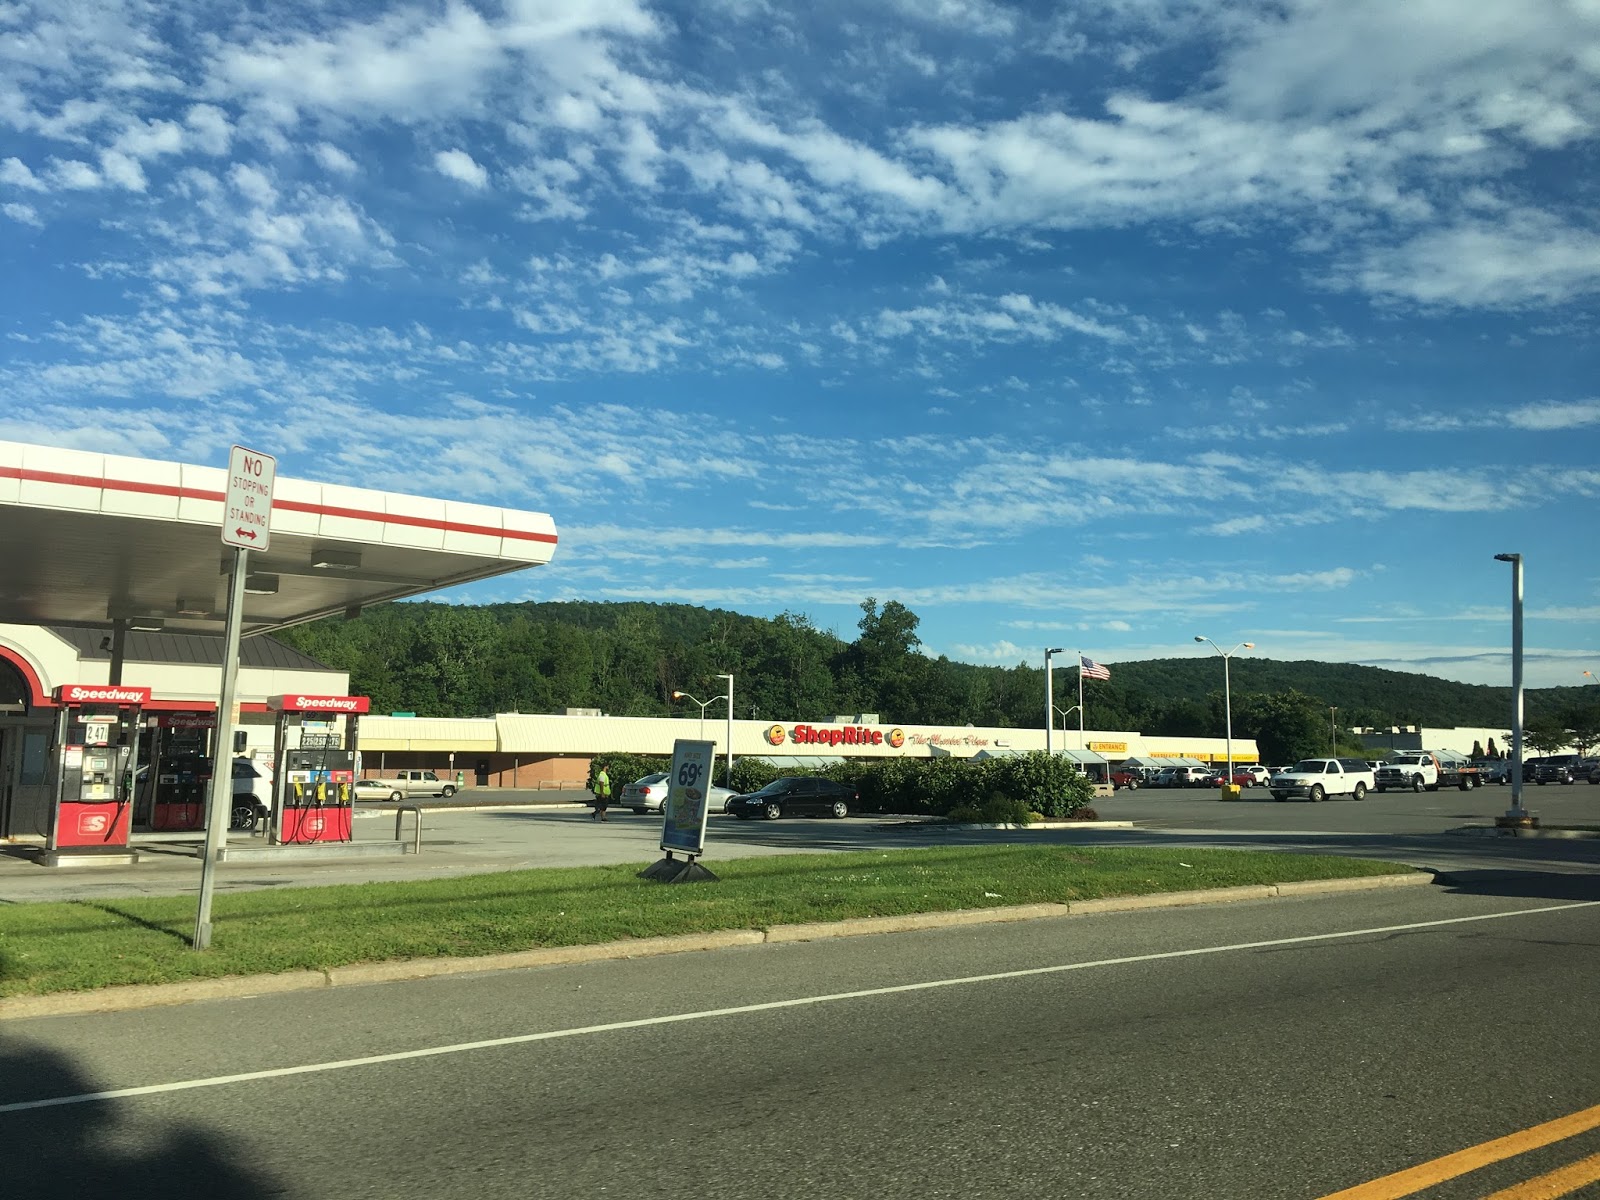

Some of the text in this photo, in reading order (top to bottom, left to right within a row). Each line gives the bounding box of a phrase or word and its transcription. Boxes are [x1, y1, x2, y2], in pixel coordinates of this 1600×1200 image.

[243, 456, 263, 477] NO
[233, 477, 269, 497] STOPPING
[244, 495, 255, 508] OR
[230, 507, 266, 527] STANDING
[70, 687, 144, 702] Speedway
[296, 697, 357, 710] Speedway
[168, 717, 215, 728] Speedway
[793, 725, 883, 746] ShopRite
[1098, 743, 1126, 751] ENTRANCE
[678, 762, 703, 787] 69¢
